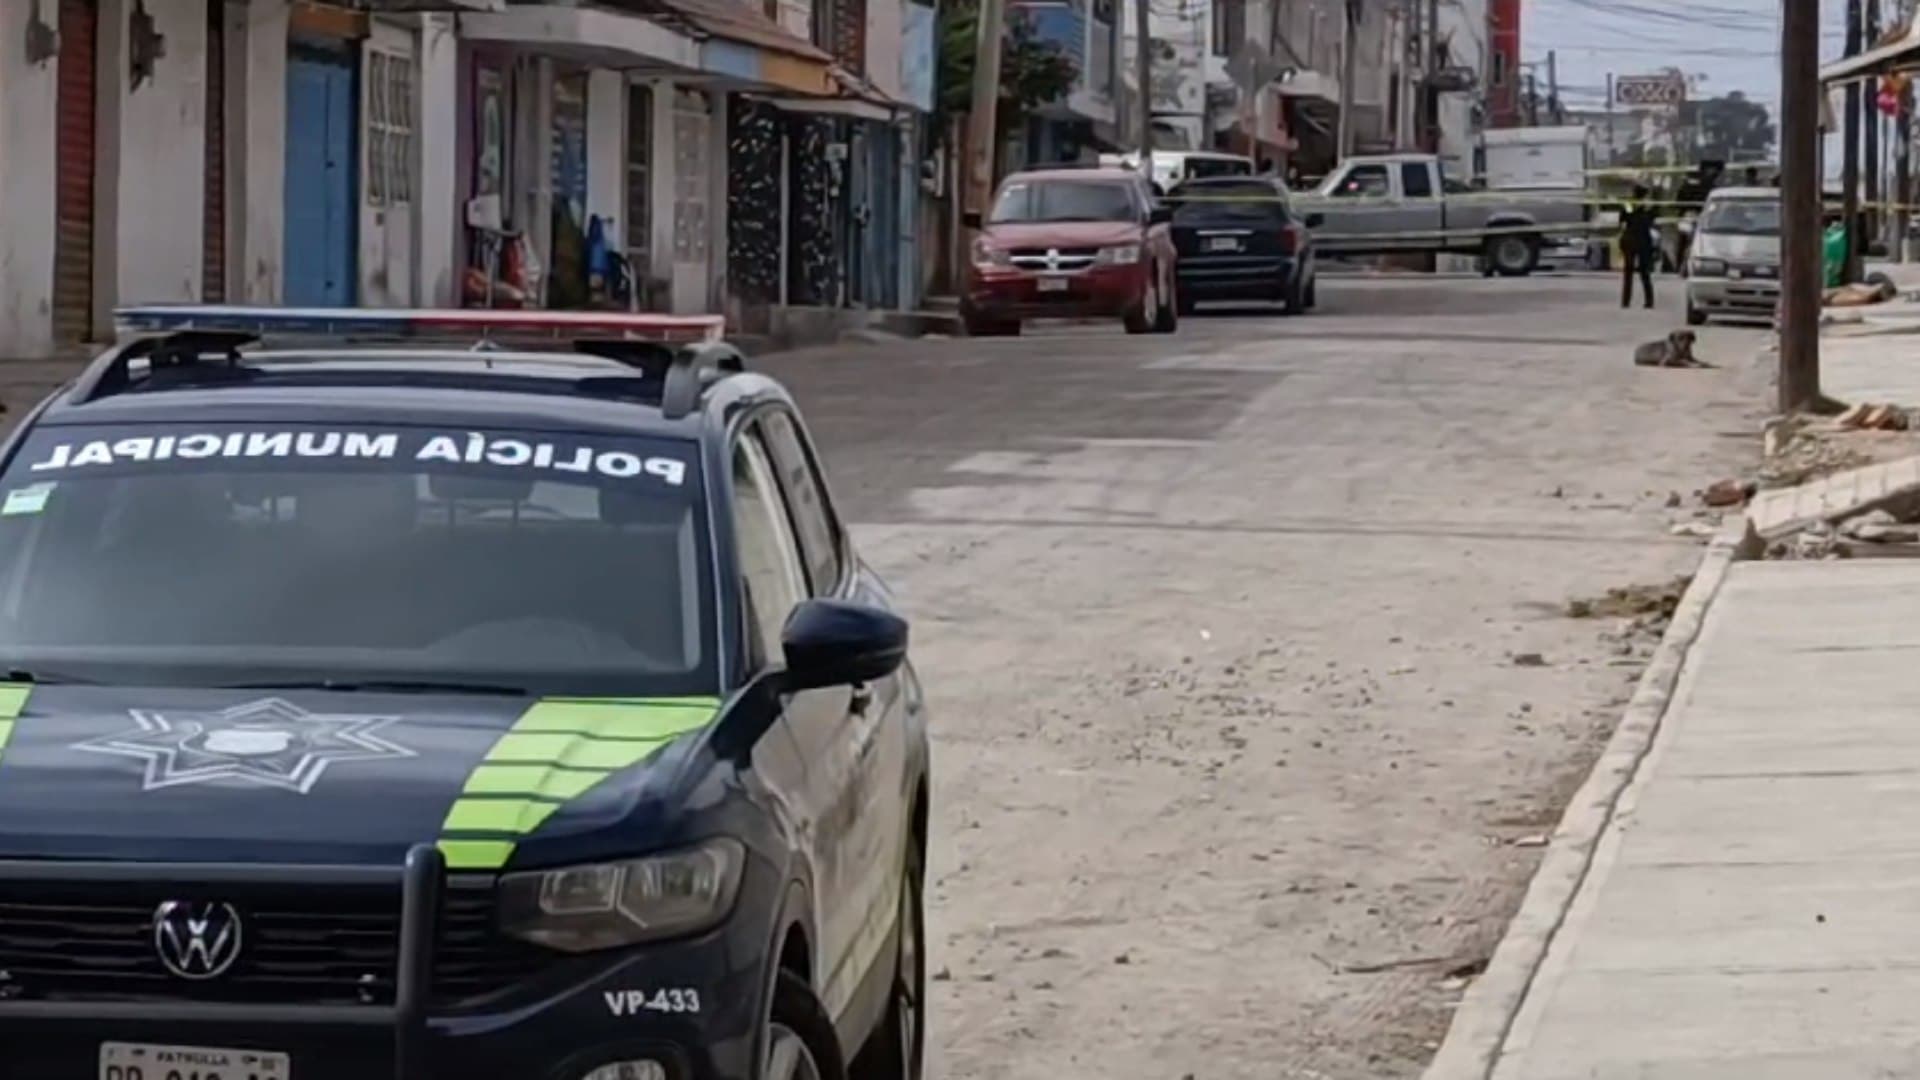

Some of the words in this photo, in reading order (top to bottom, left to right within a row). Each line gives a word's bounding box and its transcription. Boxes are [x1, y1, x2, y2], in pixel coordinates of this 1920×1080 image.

[1618, 83, 1682, 103] OXXO
[603, 987, 701, 1017] VP-433
[156, 1051, 231, 1067] PATRULLA
